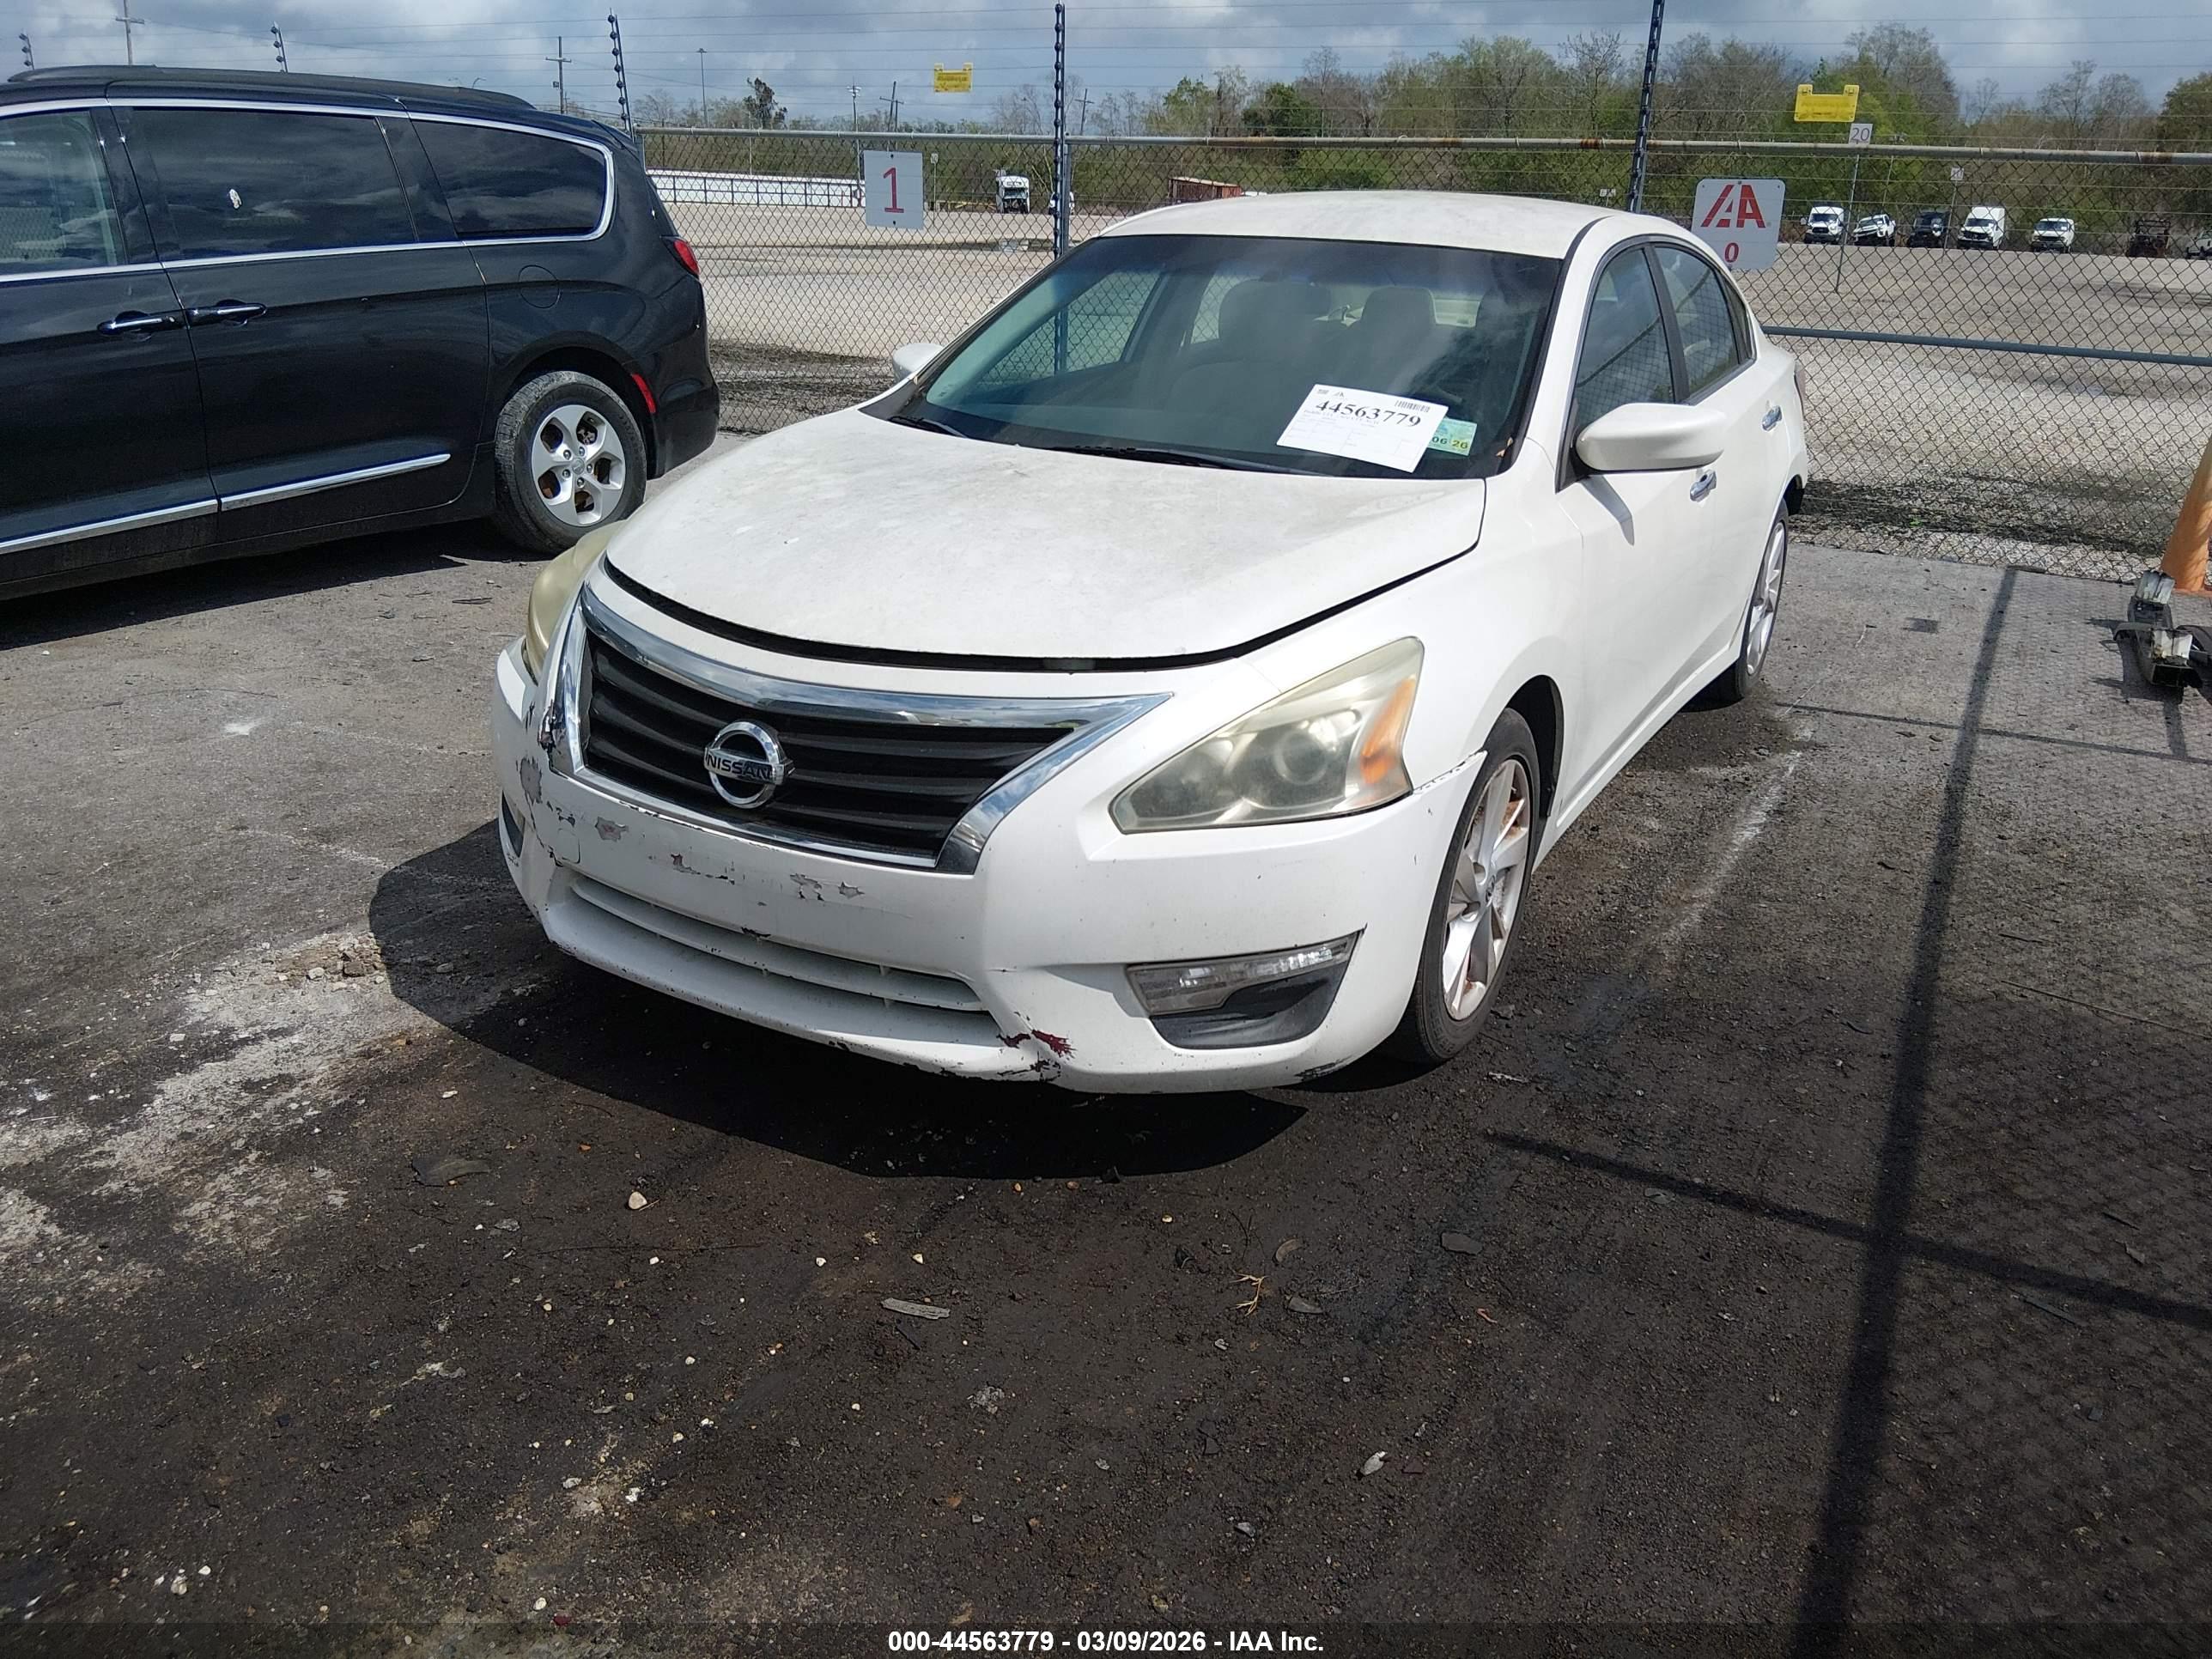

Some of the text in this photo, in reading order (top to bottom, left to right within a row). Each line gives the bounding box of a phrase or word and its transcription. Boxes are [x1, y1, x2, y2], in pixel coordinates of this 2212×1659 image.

[1850, 127, 1870, 142] 20
[883, 167, 904, 213] 1
[1724, 242, 1740, 263] 0
[1316, 399, 1422, 428] 44563779
[706, 753, 774, 781] NISSAN
